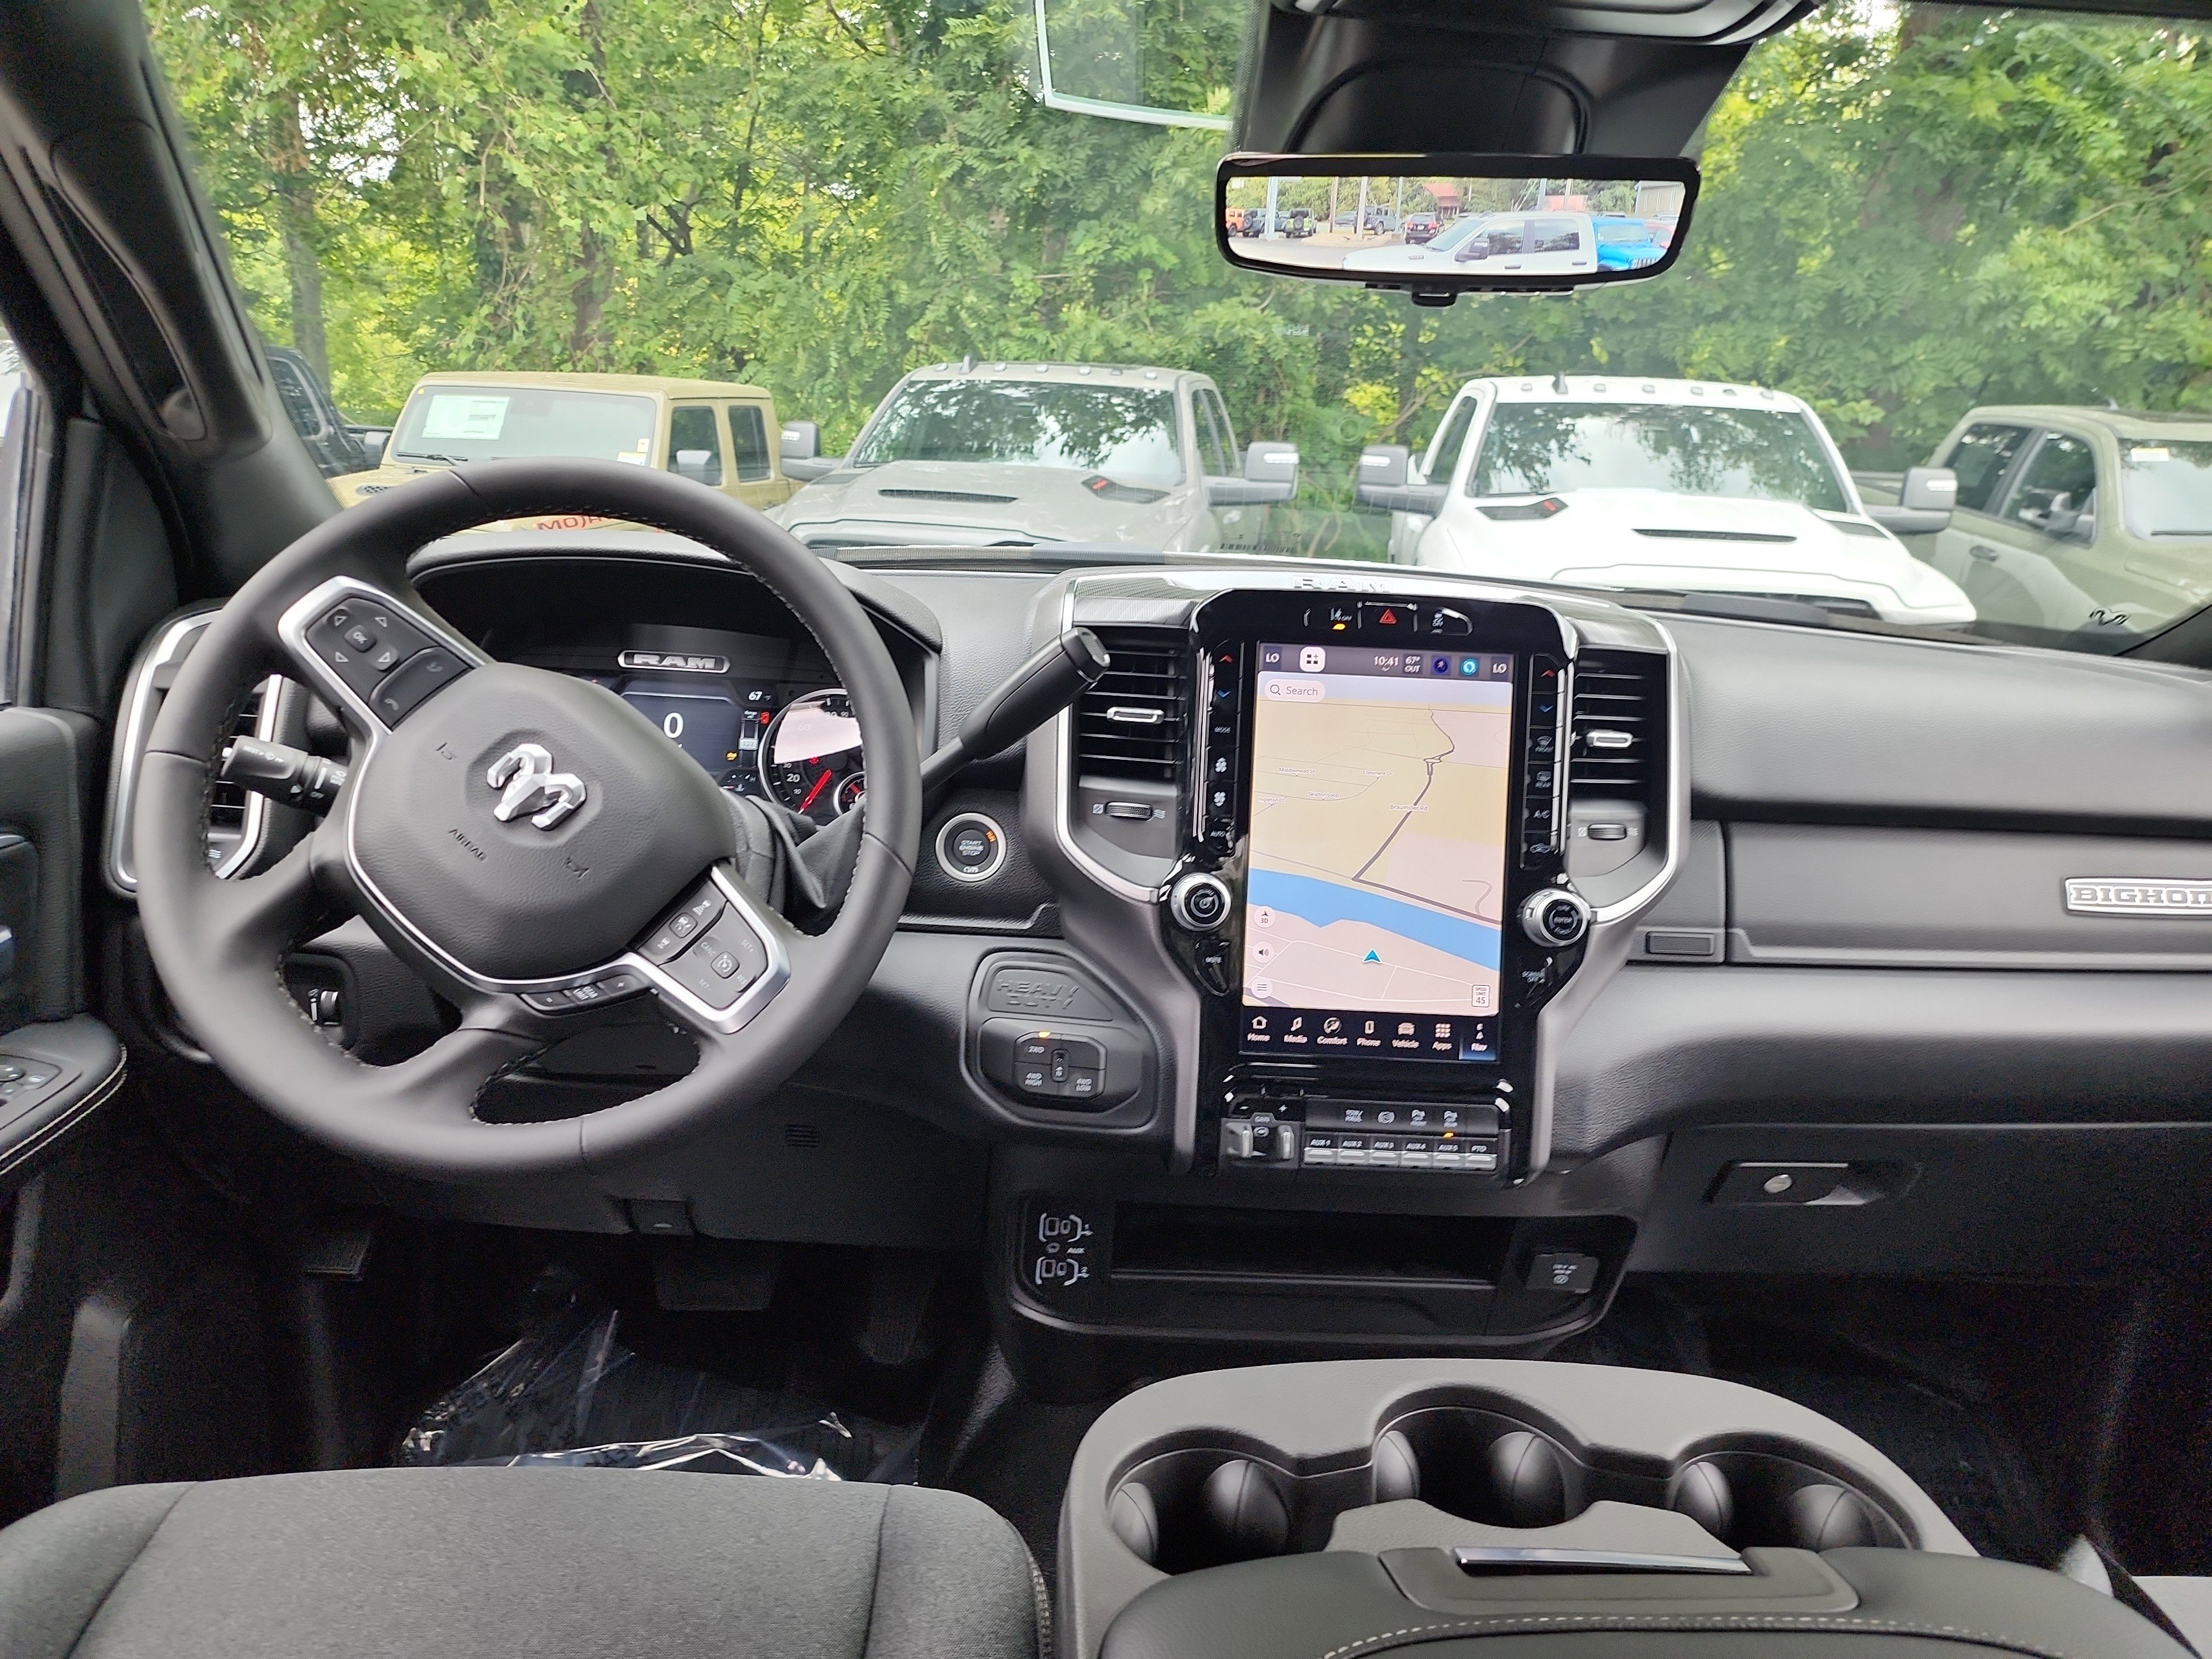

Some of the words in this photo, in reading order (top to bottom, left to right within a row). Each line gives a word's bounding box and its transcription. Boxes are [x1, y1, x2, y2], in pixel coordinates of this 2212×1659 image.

[1292, 576, 1392, 592] RAM
[353, 632, 367, 644] OK
[633, 654, 716, 669] RAM
[1265, 653, 1280, 663] LO
[1373, 656, 1399, 667] 10:41
[1493, 663, 1507, 674] LO
[748, 691, 763, 701] 67
[1286, 686, 1318, 696] Search
[664, 712, 684, 739] 0
[786, 774, 800, 782] 20
[1533, 810, 1551, 819] A/C
[997, 979, 1079, 998] HEAVY
[1247, 1032, 1271, 1042] Home
[1284, 1034, 1308, 1044] Media
[1317, 1036, 1348, 1045] Comfort
[1357, 1038, 1381, 1047] Phone
[1392, 1039, 1420, 1048] Vehicle
[1432, 1041, 1453, 1051] Apps
[1472, 1043, 1488, 1051] Nav
